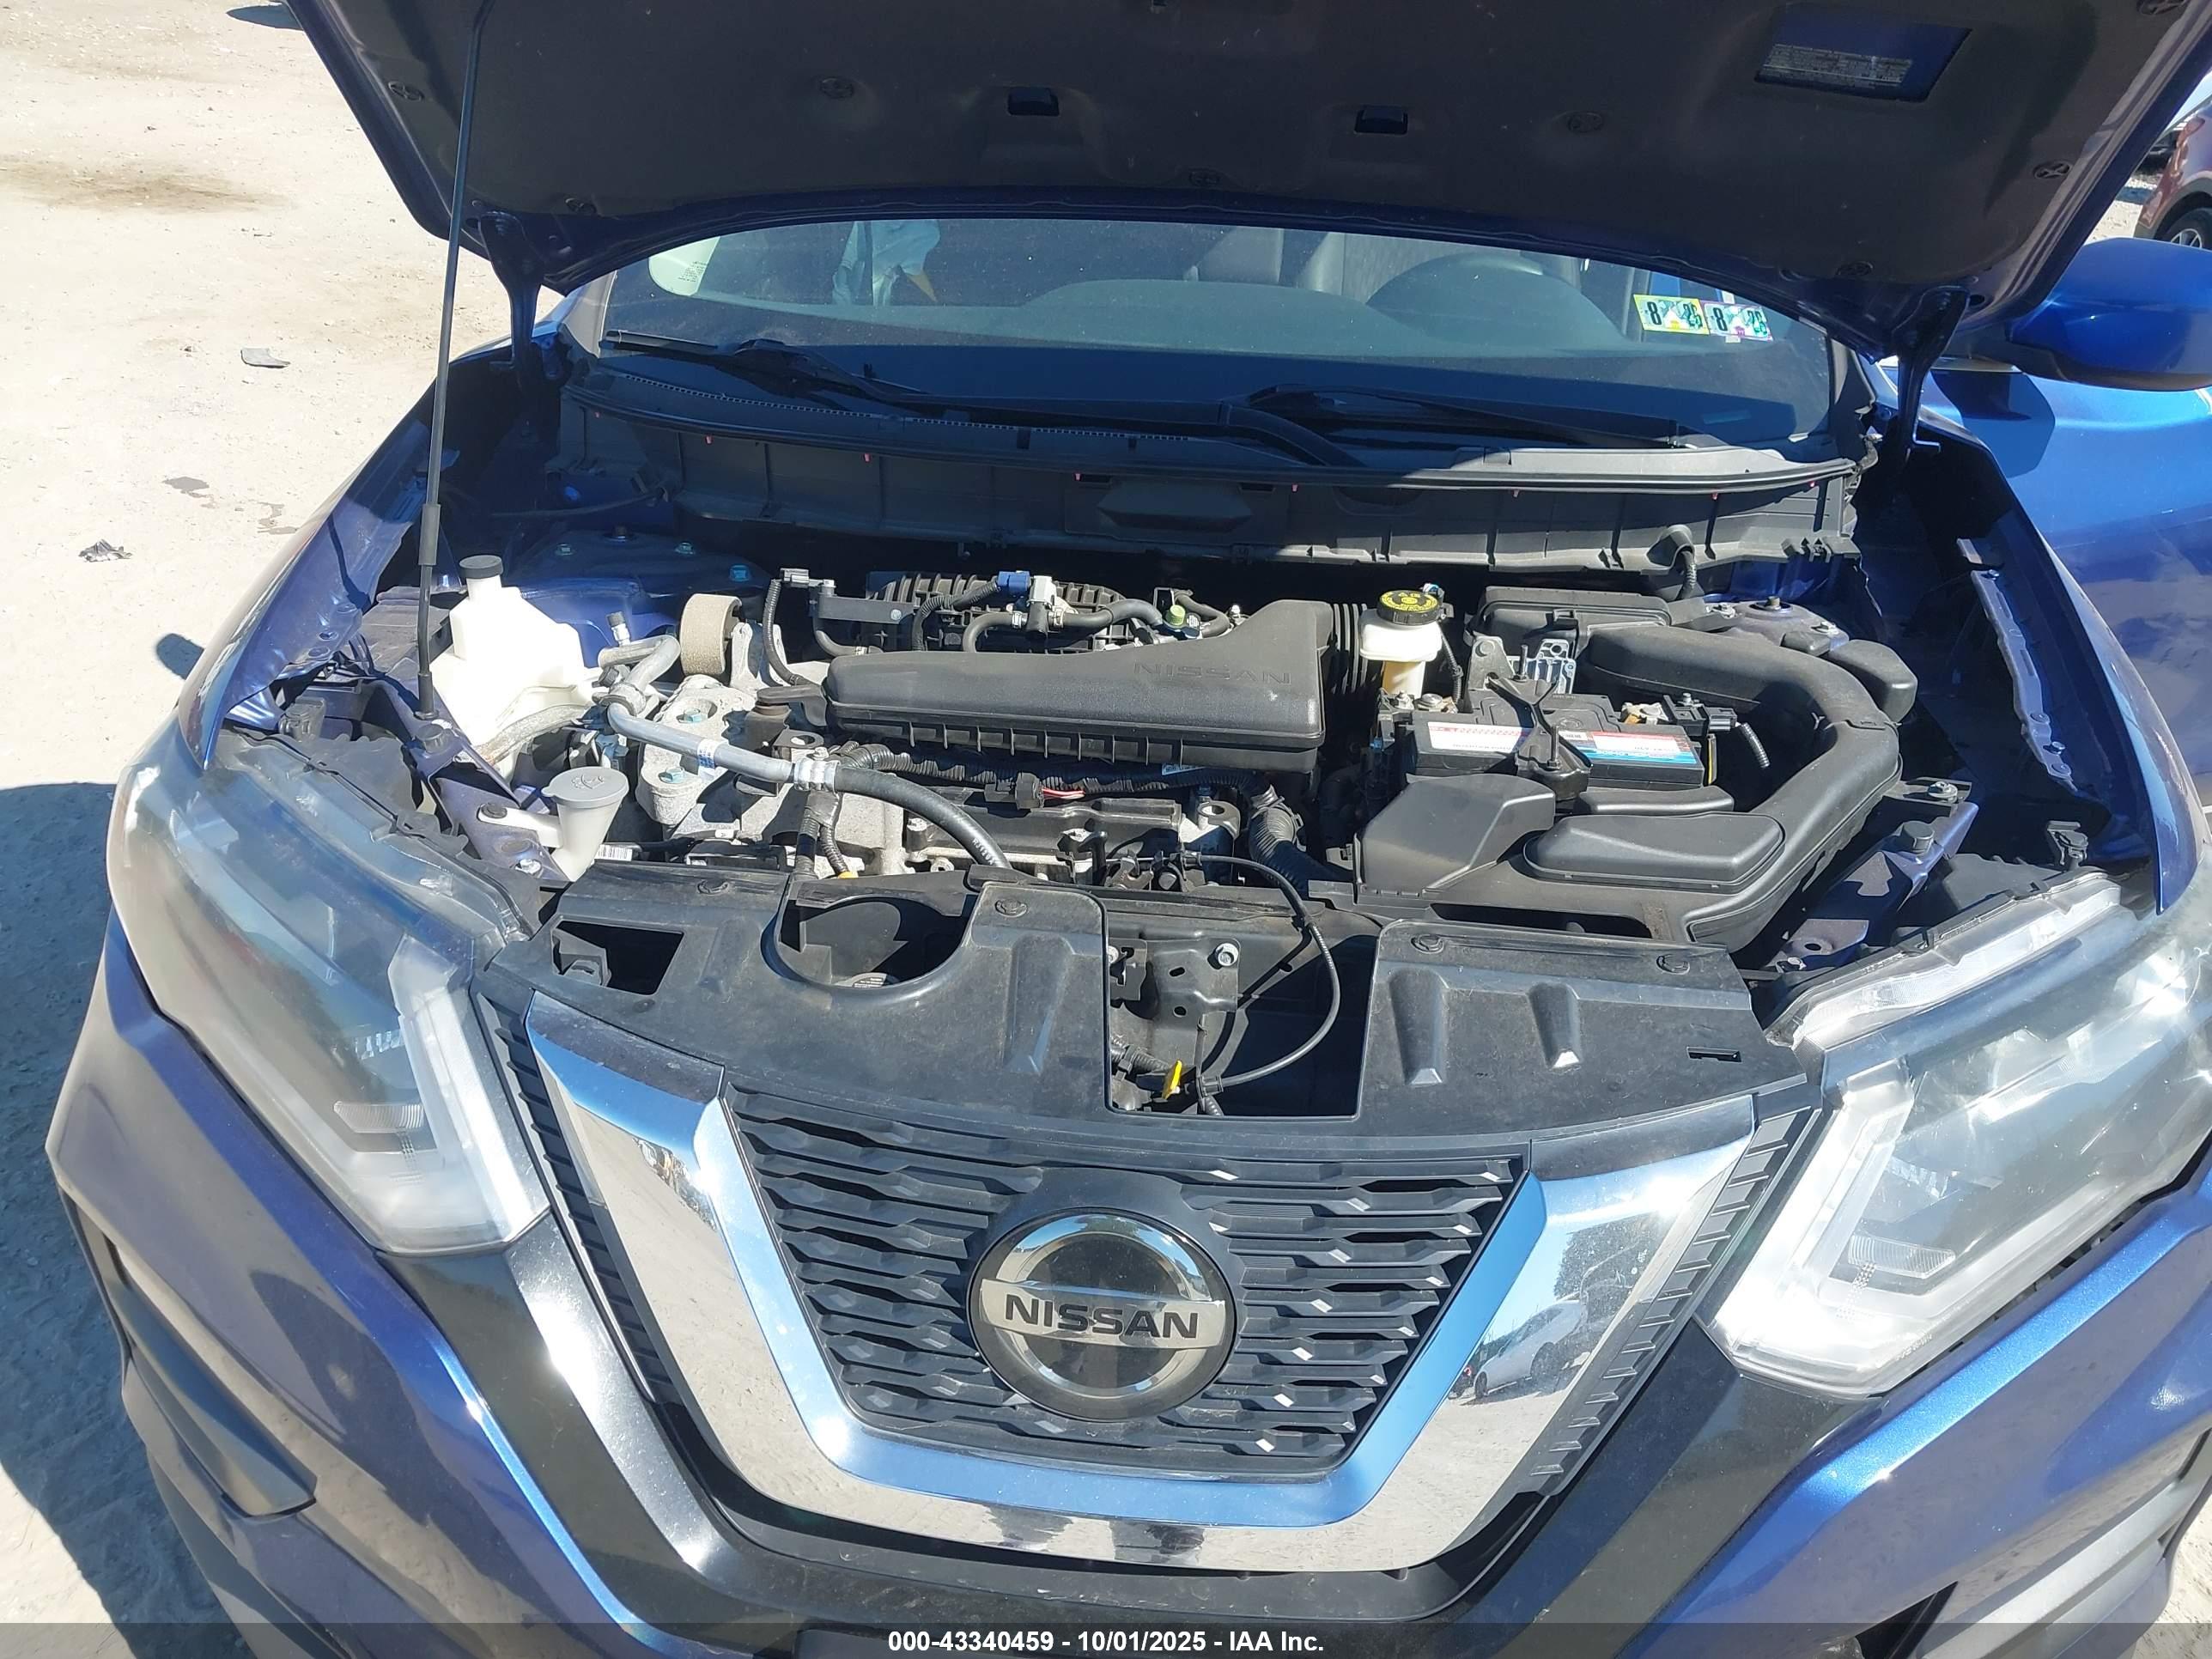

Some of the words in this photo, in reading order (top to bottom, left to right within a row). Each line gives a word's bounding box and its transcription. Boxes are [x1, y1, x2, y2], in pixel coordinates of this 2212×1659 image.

[1647, 301, 1662, 325] 8
[1712, 307, 1728, 331] 8
[1133, 659, 1291, 684] NISSAN
[1005, 1294, 1199, 1339] NISSAN
